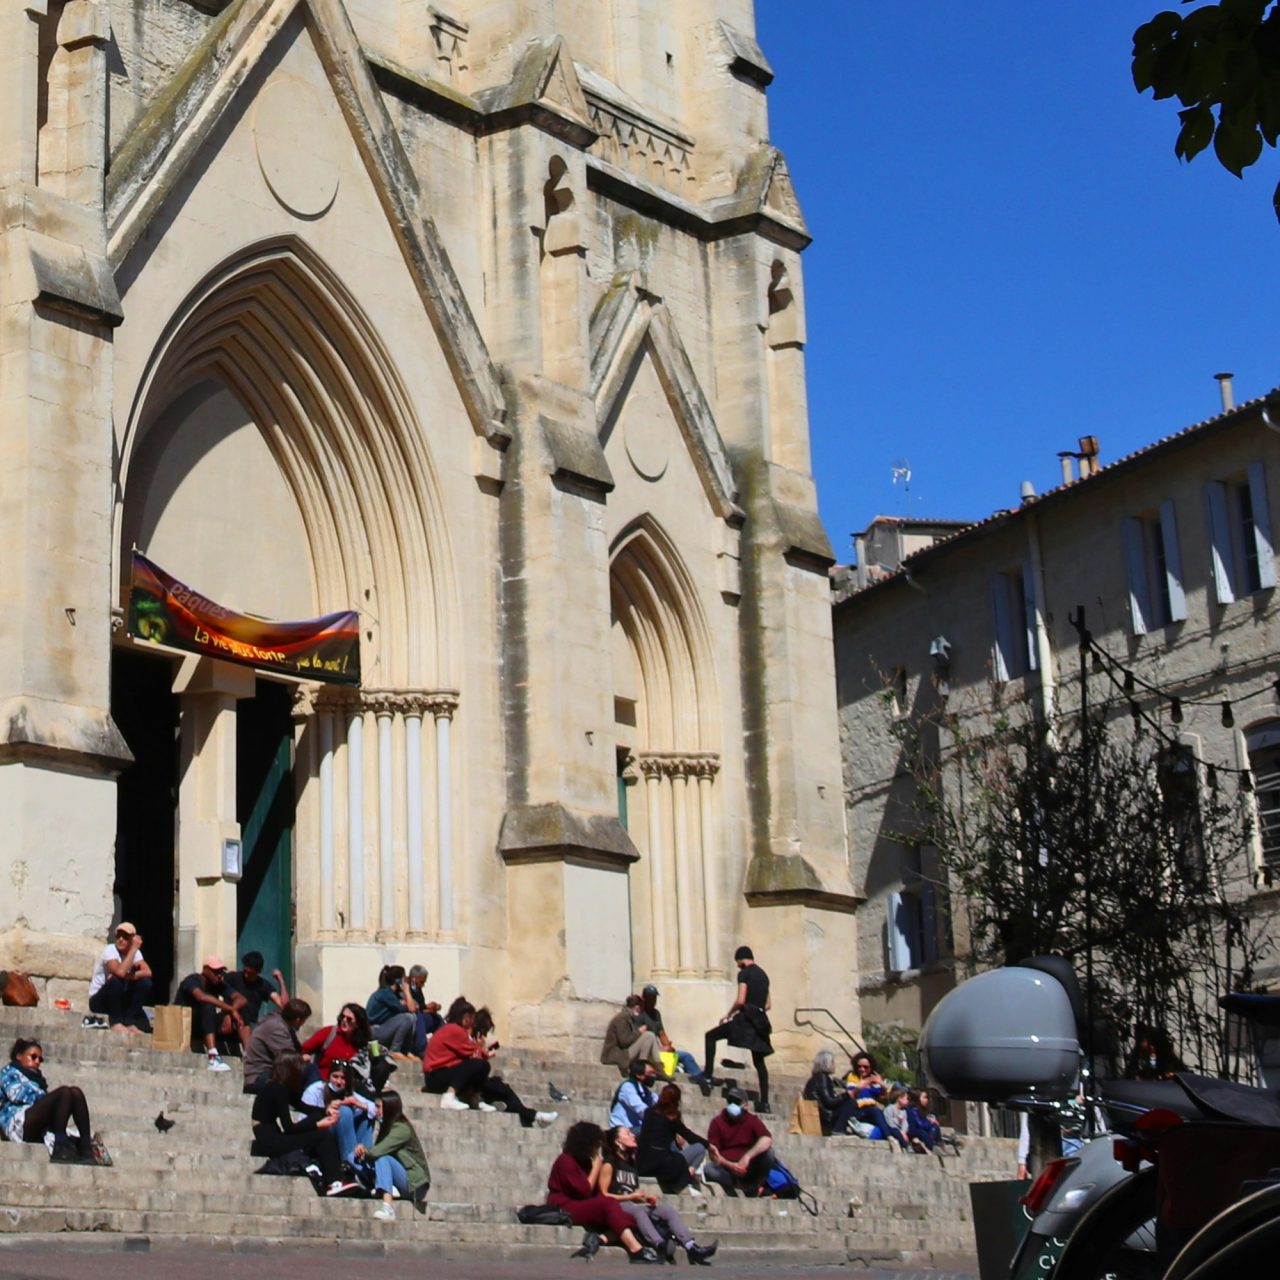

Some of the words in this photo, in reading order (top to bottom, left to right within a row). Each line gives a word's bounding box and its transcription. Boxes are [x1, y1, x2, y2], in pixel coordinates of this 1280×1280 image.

[194, 625, 210, 644] La
[211, 635, 228, 650] vie
[229, 640, 254, 658] plus
